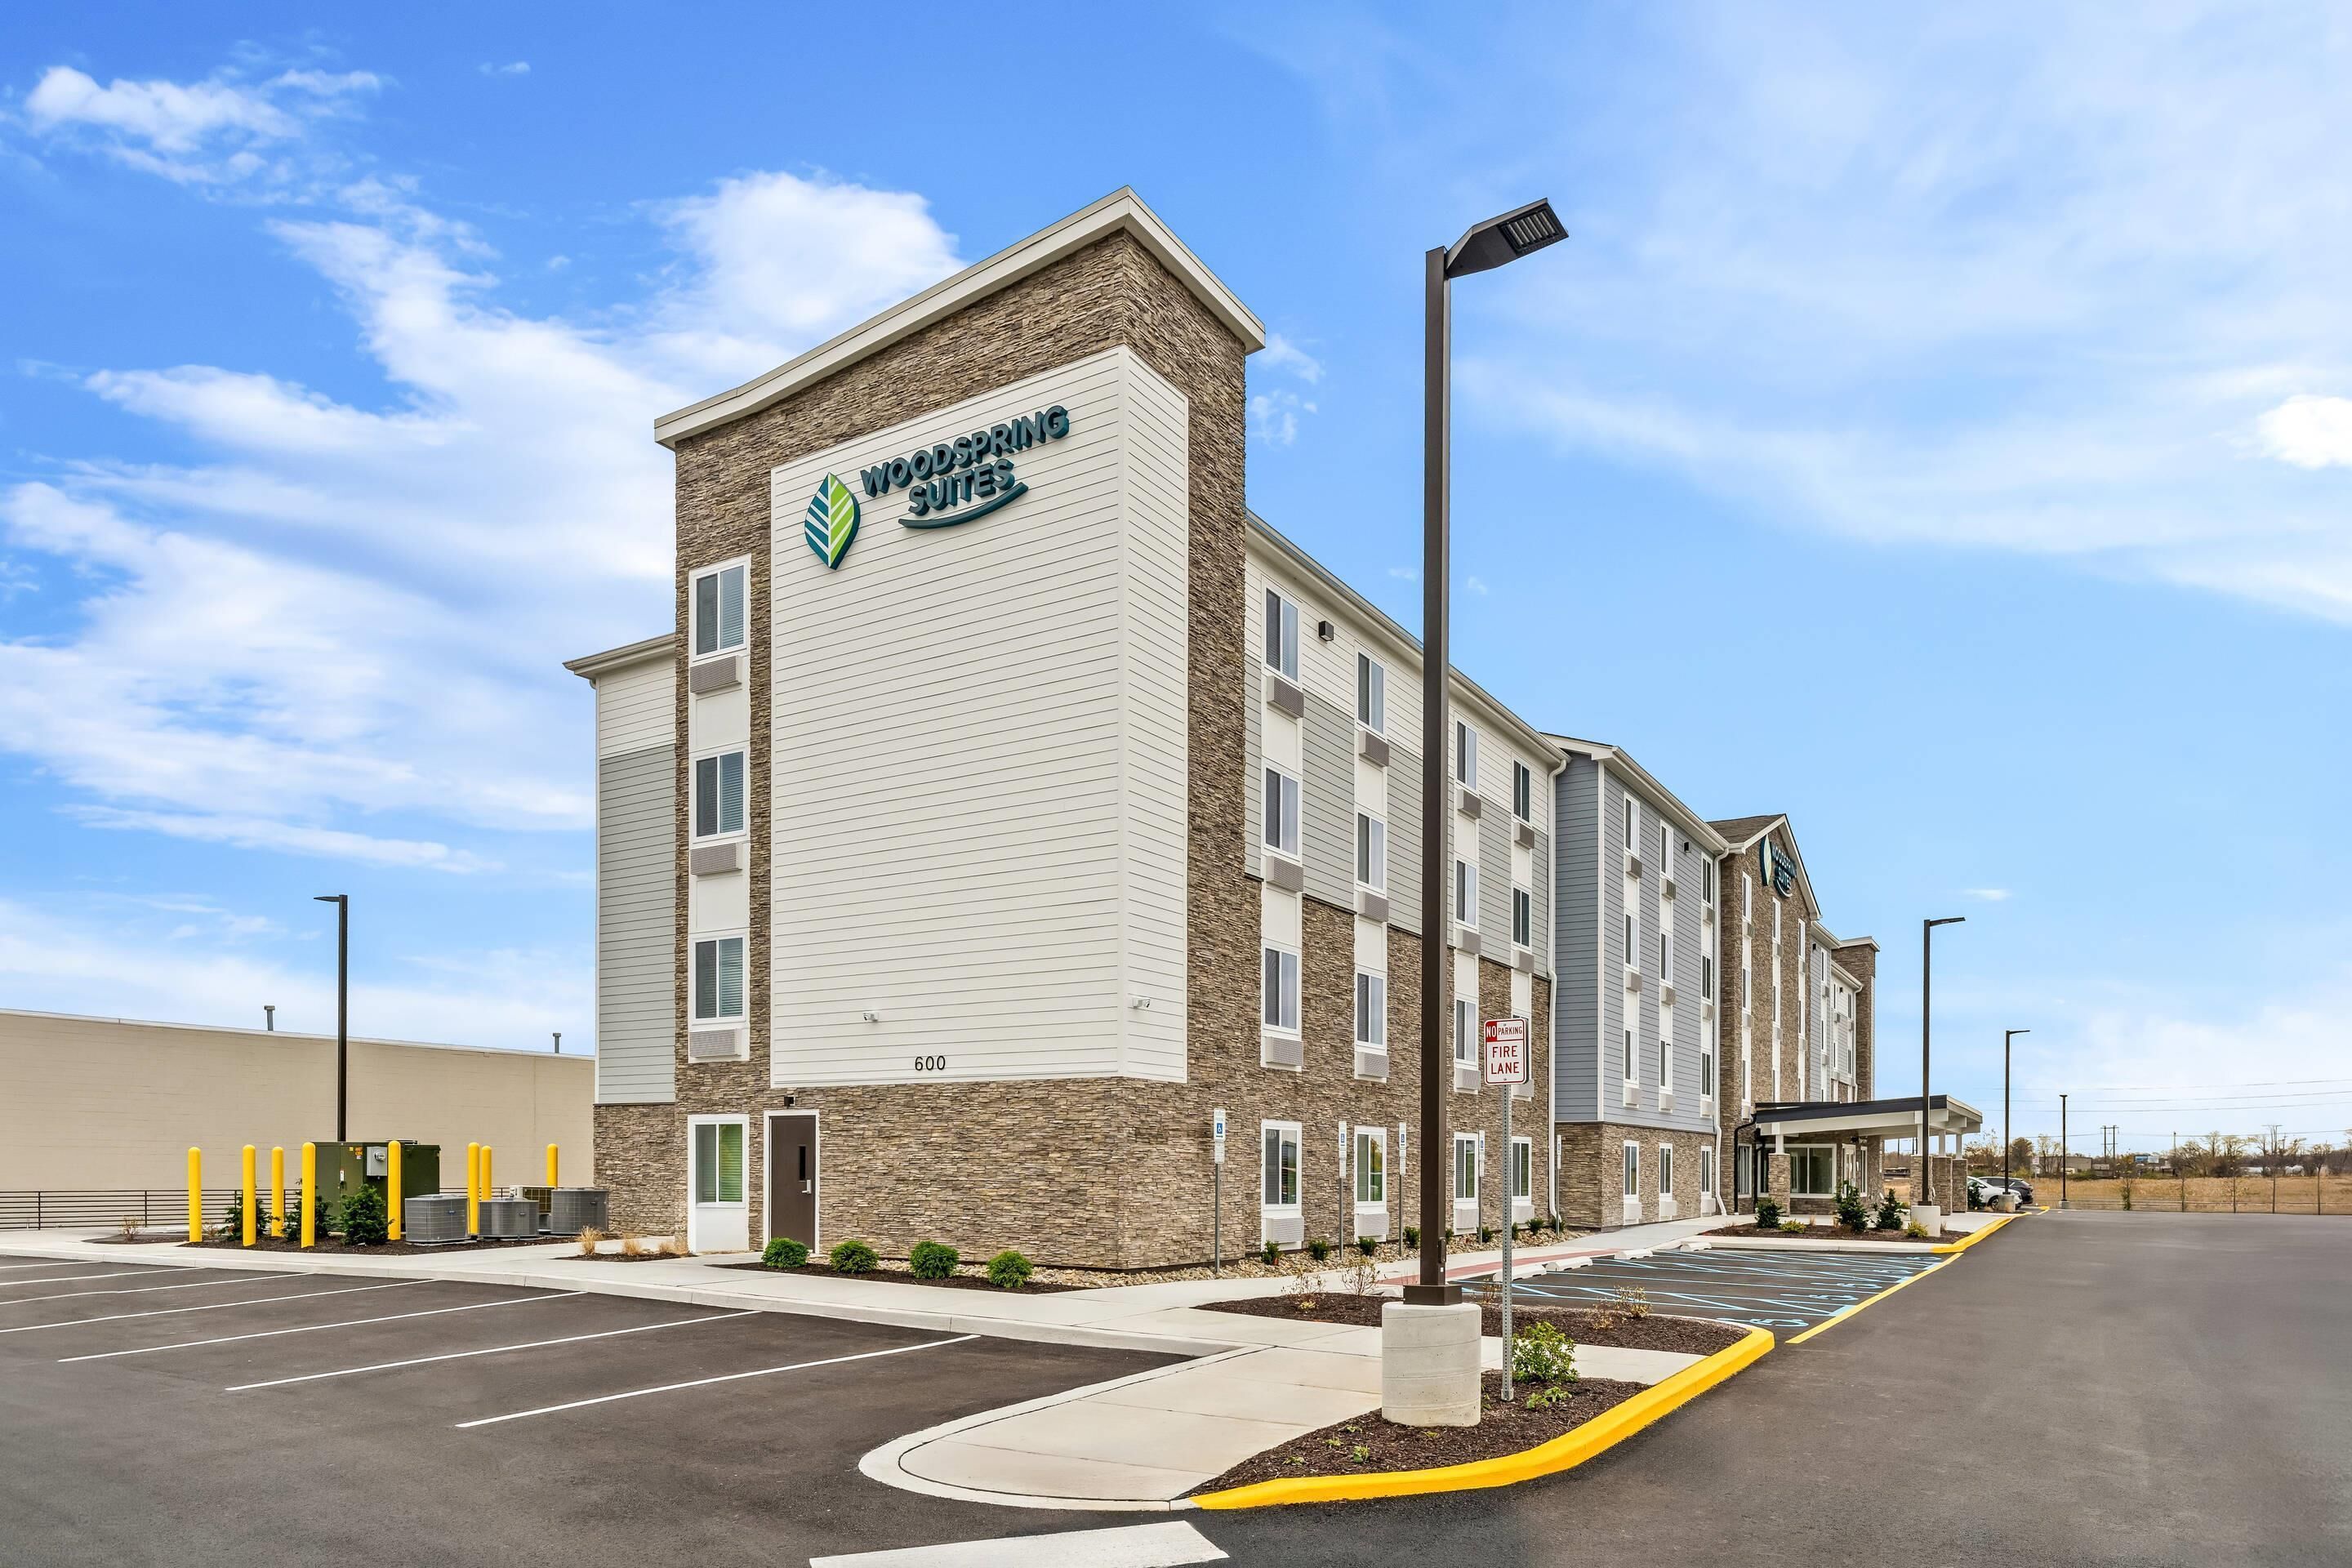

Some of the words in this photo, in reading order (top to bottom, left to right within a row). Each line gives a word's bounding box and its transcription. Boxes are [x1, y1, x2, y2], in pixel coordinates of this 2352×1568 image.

[860, 405, 1070, 497] WOODSPRING
[908, 458, 1014, 516] SUITES
[1486, 1026, 1496, 1037] NO
[1498, 1026, 1522, 1036] PARKING
[1492, 1045, 1518, 1058] FIRE
[915, 1055, 946, 1071] 600
[1490, 1062, 1520, 1075] LANE
